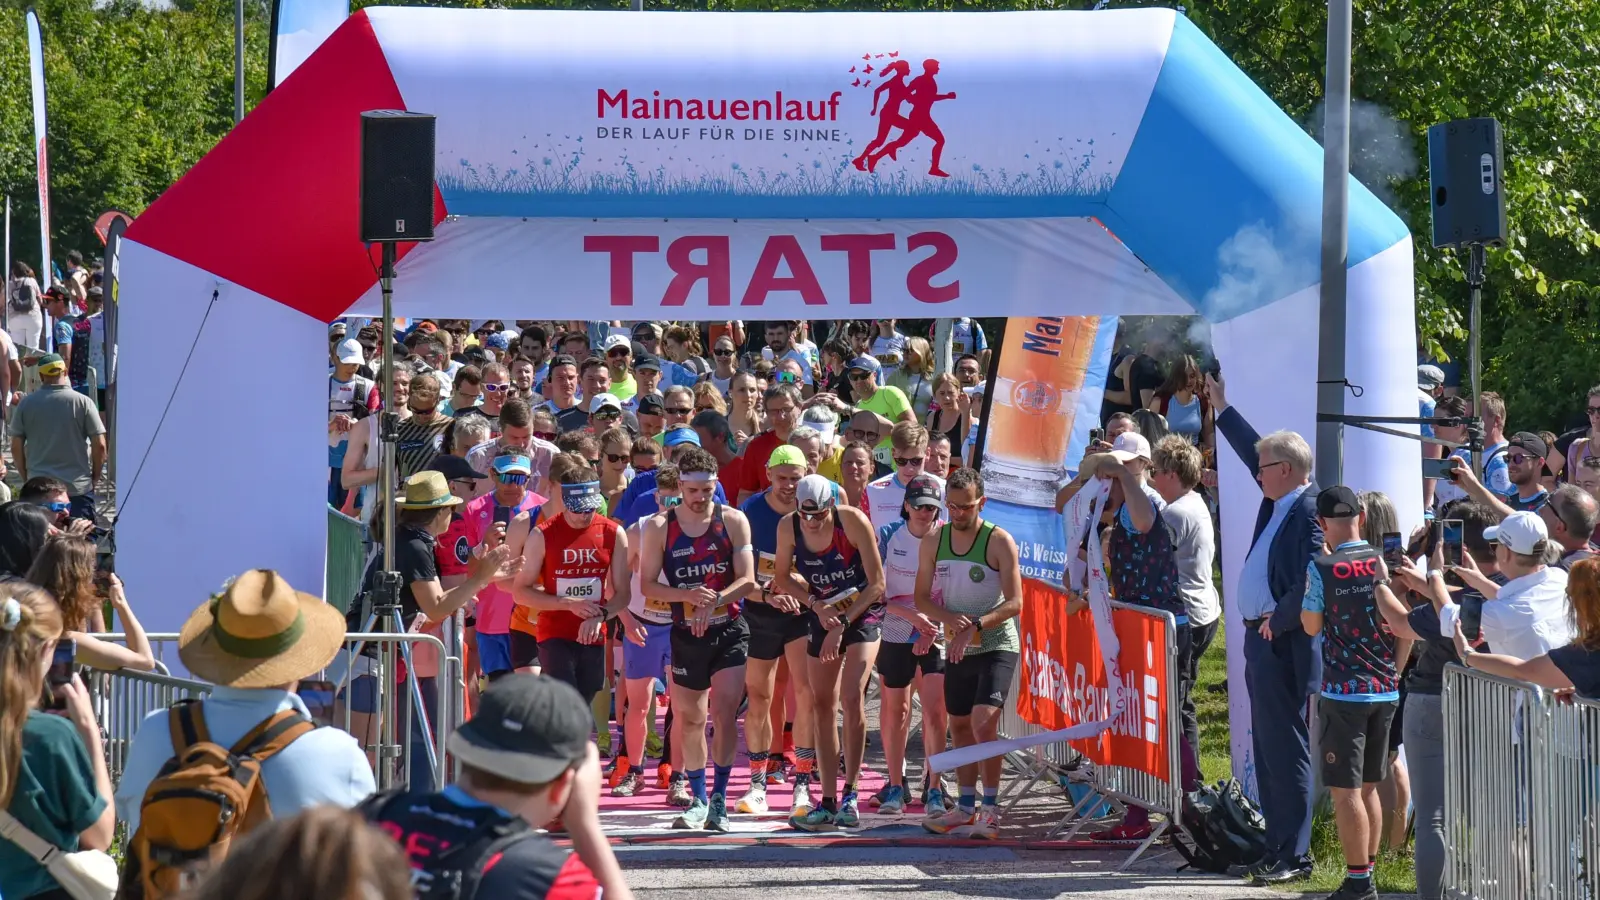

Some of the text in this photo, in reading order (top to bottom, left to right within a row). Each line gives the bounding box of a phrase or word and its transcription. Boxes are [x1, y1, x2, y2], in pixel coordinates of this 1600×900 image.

[597, 88, 842, 121] Mainauenlauf
[597, 125, 841, 142] DER LAUF FÜR DIE SINNE
[562, 548, 600, 566] DJK
[565, 585, 593, 597] 4055
[1335, 588, 1350, 596] Der
